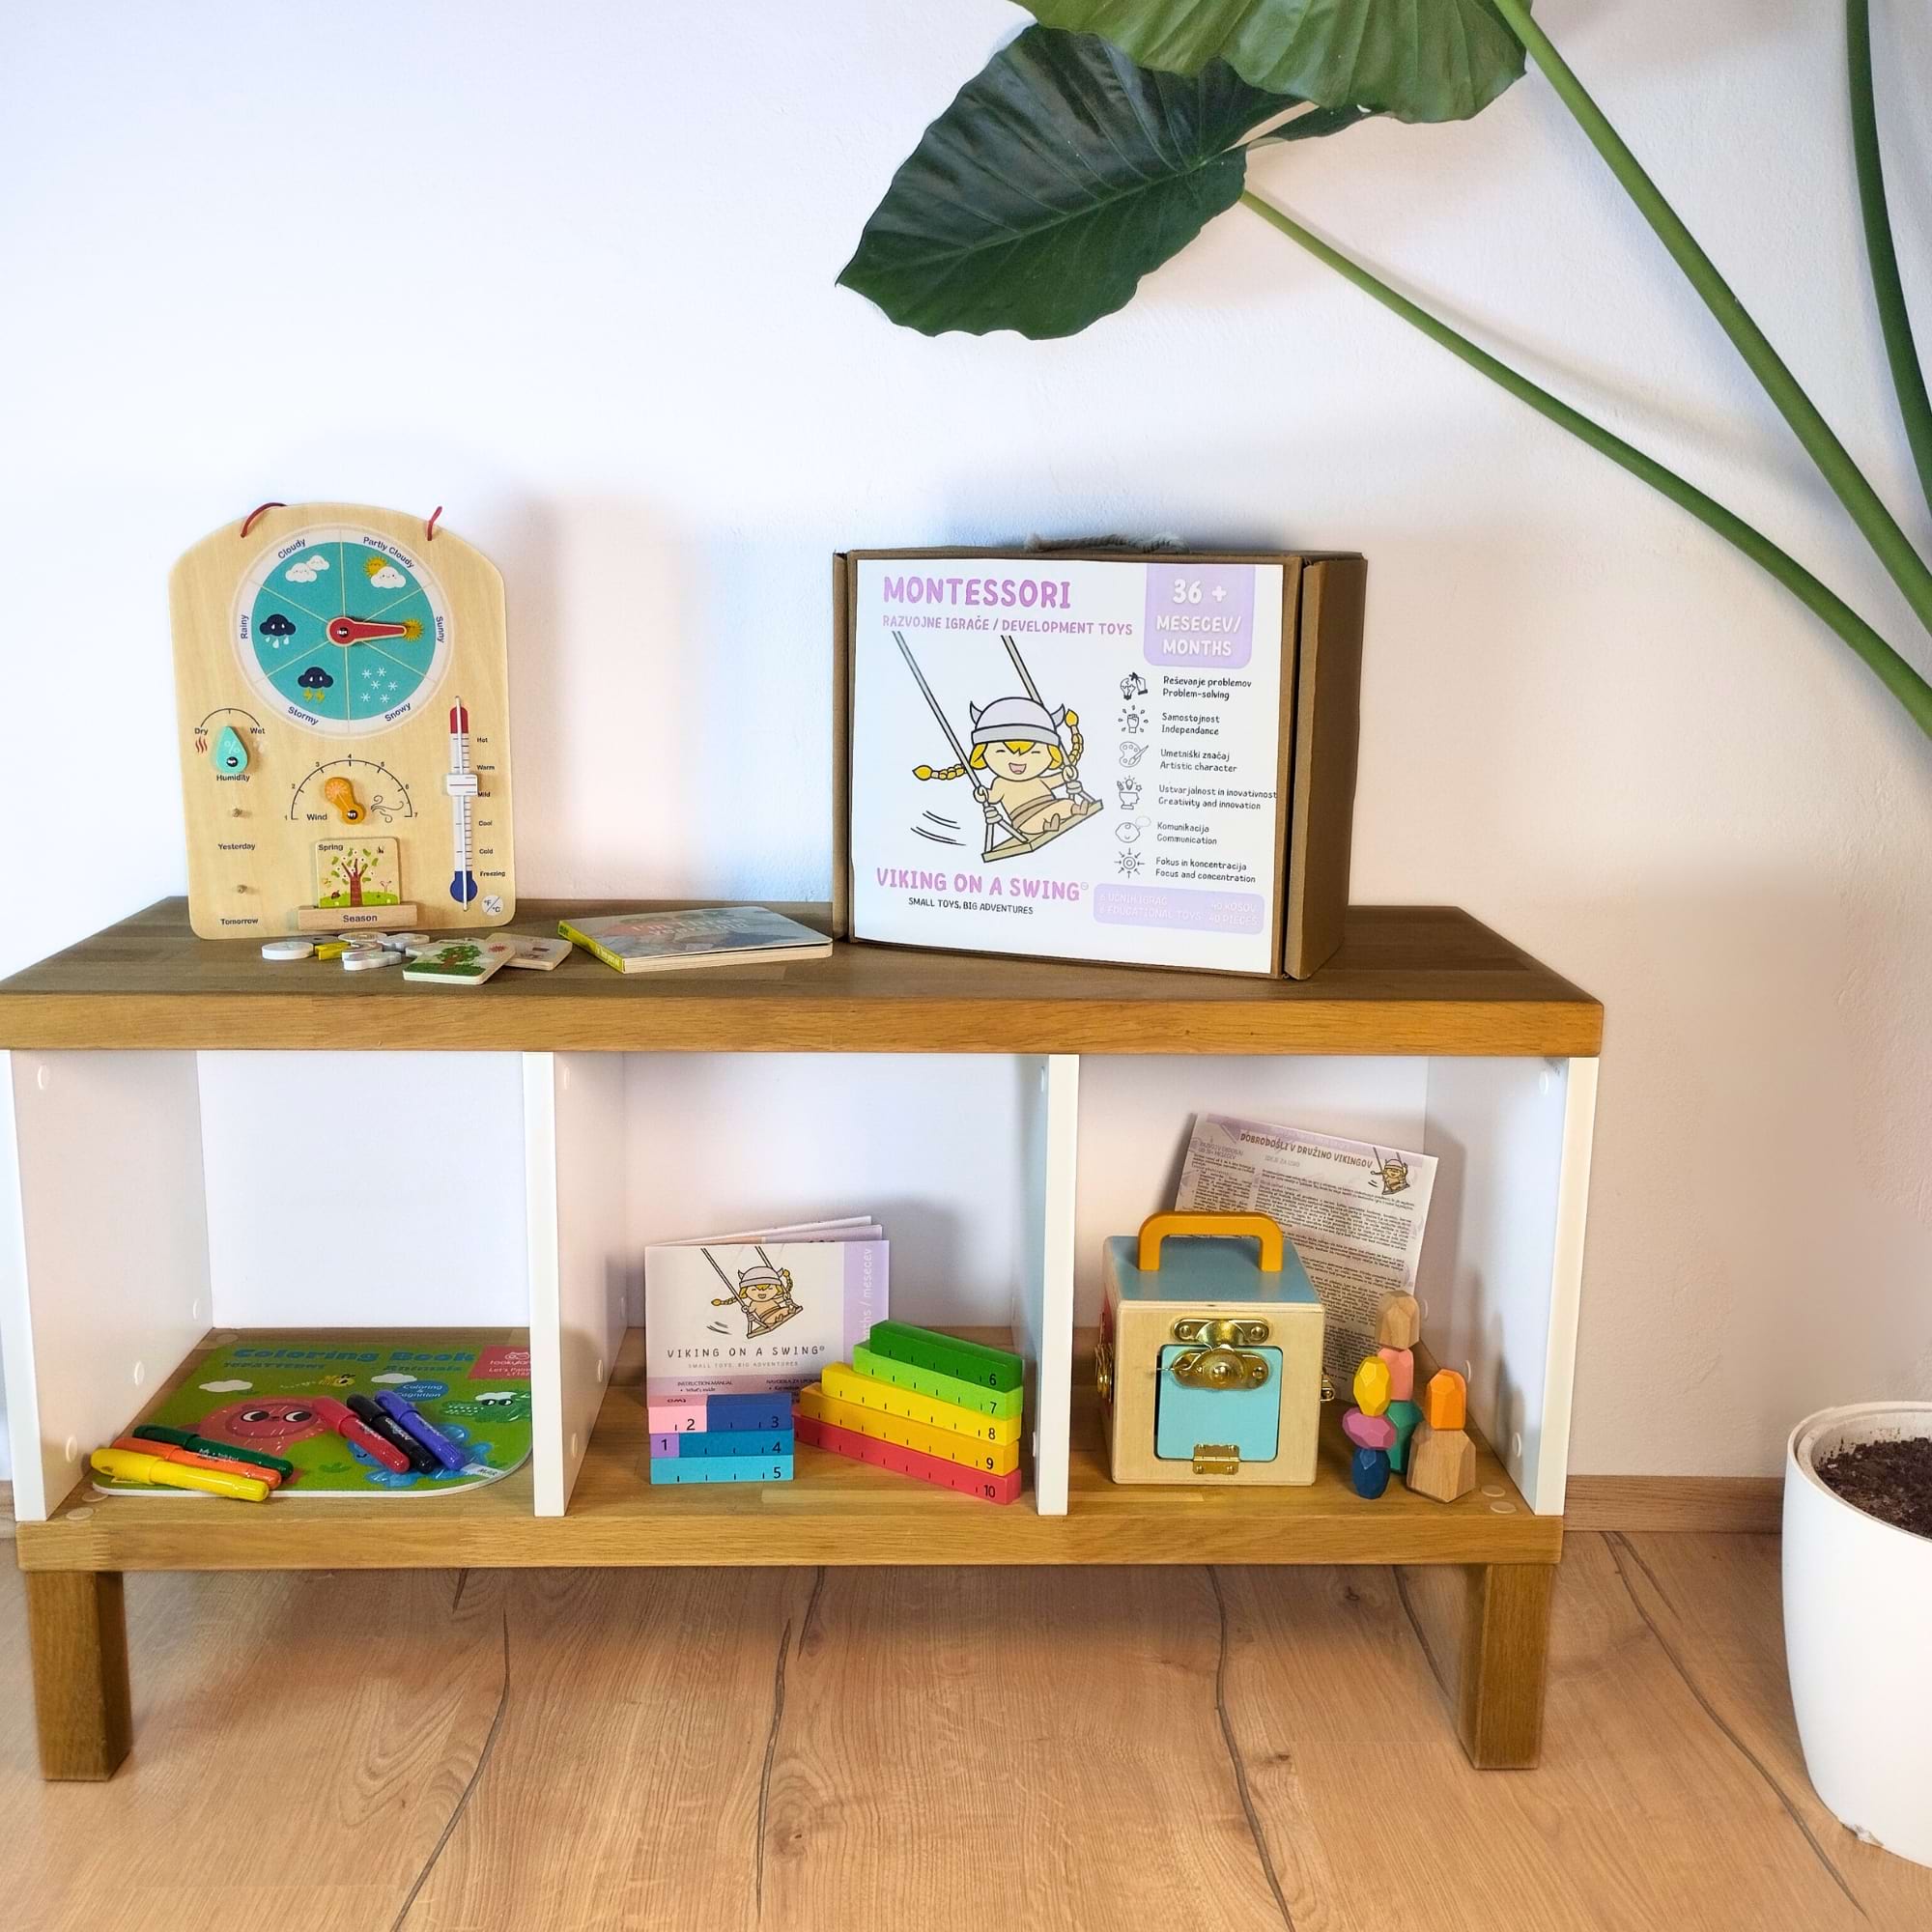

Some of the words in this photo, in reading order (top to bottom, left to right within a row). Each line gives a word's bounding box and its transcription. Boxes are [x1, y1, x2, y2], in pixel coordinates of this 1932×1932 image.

[277, 537, 306, 560] Cloudy
[362, 536, 388, 552] Partly
[388, 546, 415, 569] Cloudy
[883, 576, 1071, 610] MONTESSORI
[1172, 579, 1203, 605] 36
[1211, 585, 1227, 602] +
[240, 614, 250, 639] Rainy
[435, 615, 444, 643] Sunny
[882, 614, 942, 629] RAZVOJNE
[992, 618, 999, 631] /
[1002, 619, 1094, 635] DEVELOPMENT
[1098, 622, 1133, 636] TOYS
[1162, 639, 1233, 657] MONTHS
[1163, 675, 1206, 689] Reševanje
[1208, 677, 1252, 688] problemov
[1162, 688, 1230, 701] Problem-solving
[287, 705, 320, 725] Stormy
[384, 702, 412, 723] Snowy
[1162, 712, 1220, 724] Samostojnost
[194, 727, 209, 736] Dry
[1160, 749, 1201, 759] Umetniški
[1202, 752, 1230, 762] značaj
[1159, 761, 1193, 771] Artistic
[1195, 762, 1237, 773] character
[215, 774, 250, 782] Humidity
[1158, 784, 1216, 796] Ustvarjalnost
[1226, 789, 1277, 799] inovativnost
[1158, 796, 1200, 810] Creativity
[1202, 799, 1217, 808] and
[1219, 801, 1261, 810] innovation
[1157, 821, 1209, 835] Komunikacija
[1156, 833, 1217, 845] Communication
[217, 842, 256, 851] Yesterday
[318, 843, 344, 852] Spring
[1155, 856, 1179, 867] Fokus
[1189, 858, 1247, 872] koncentracija
[876, 867, 947, 892] VIKING
[952, 872, 982, 894] ON
[989, 876, 1003, 896] A
[1155, 868, 1179, 878] Focus
[1180, 870, 1196, 879] and
[1197, 872, 1256, 883] concentration
[908, 896, 935, 907] SMALL
[962, 901, 978, 911] BIG
[979, 903, 1034, 915] ADVENTURES
[342, 914, 378, 923] Season
[1239, 1132, 1289, 1151] DOBRODOŠLI
[1296, 1145, 1332, 1160] DRUŽINO
[1333, 1151, 1373, 1169] VIKINGOV
[234, 1349, 380, 1362] Coloring
[390, 1351, 476, 1361] Book
[667, 1348, 720, 1358] VIKING
[728, 1347, 747, 1356] ON
[755, 1347, 763, 1356] A
[988, 1373, 997, 1386] 6
[989, 1401, 997, 1414] 7
[686, 1418, 696, 1431] 2
[771, 1415, 780, 1429] 3
[988, 1428, 996, 1440] 8
[661, 1438, 668, 1451] 1
[772, 1441, 781, 1454] 4
[985, 1457, 994, 1470] 9
[773, 1466, 781, 1479] 5
[983, 1484, 996, 1498] 10
